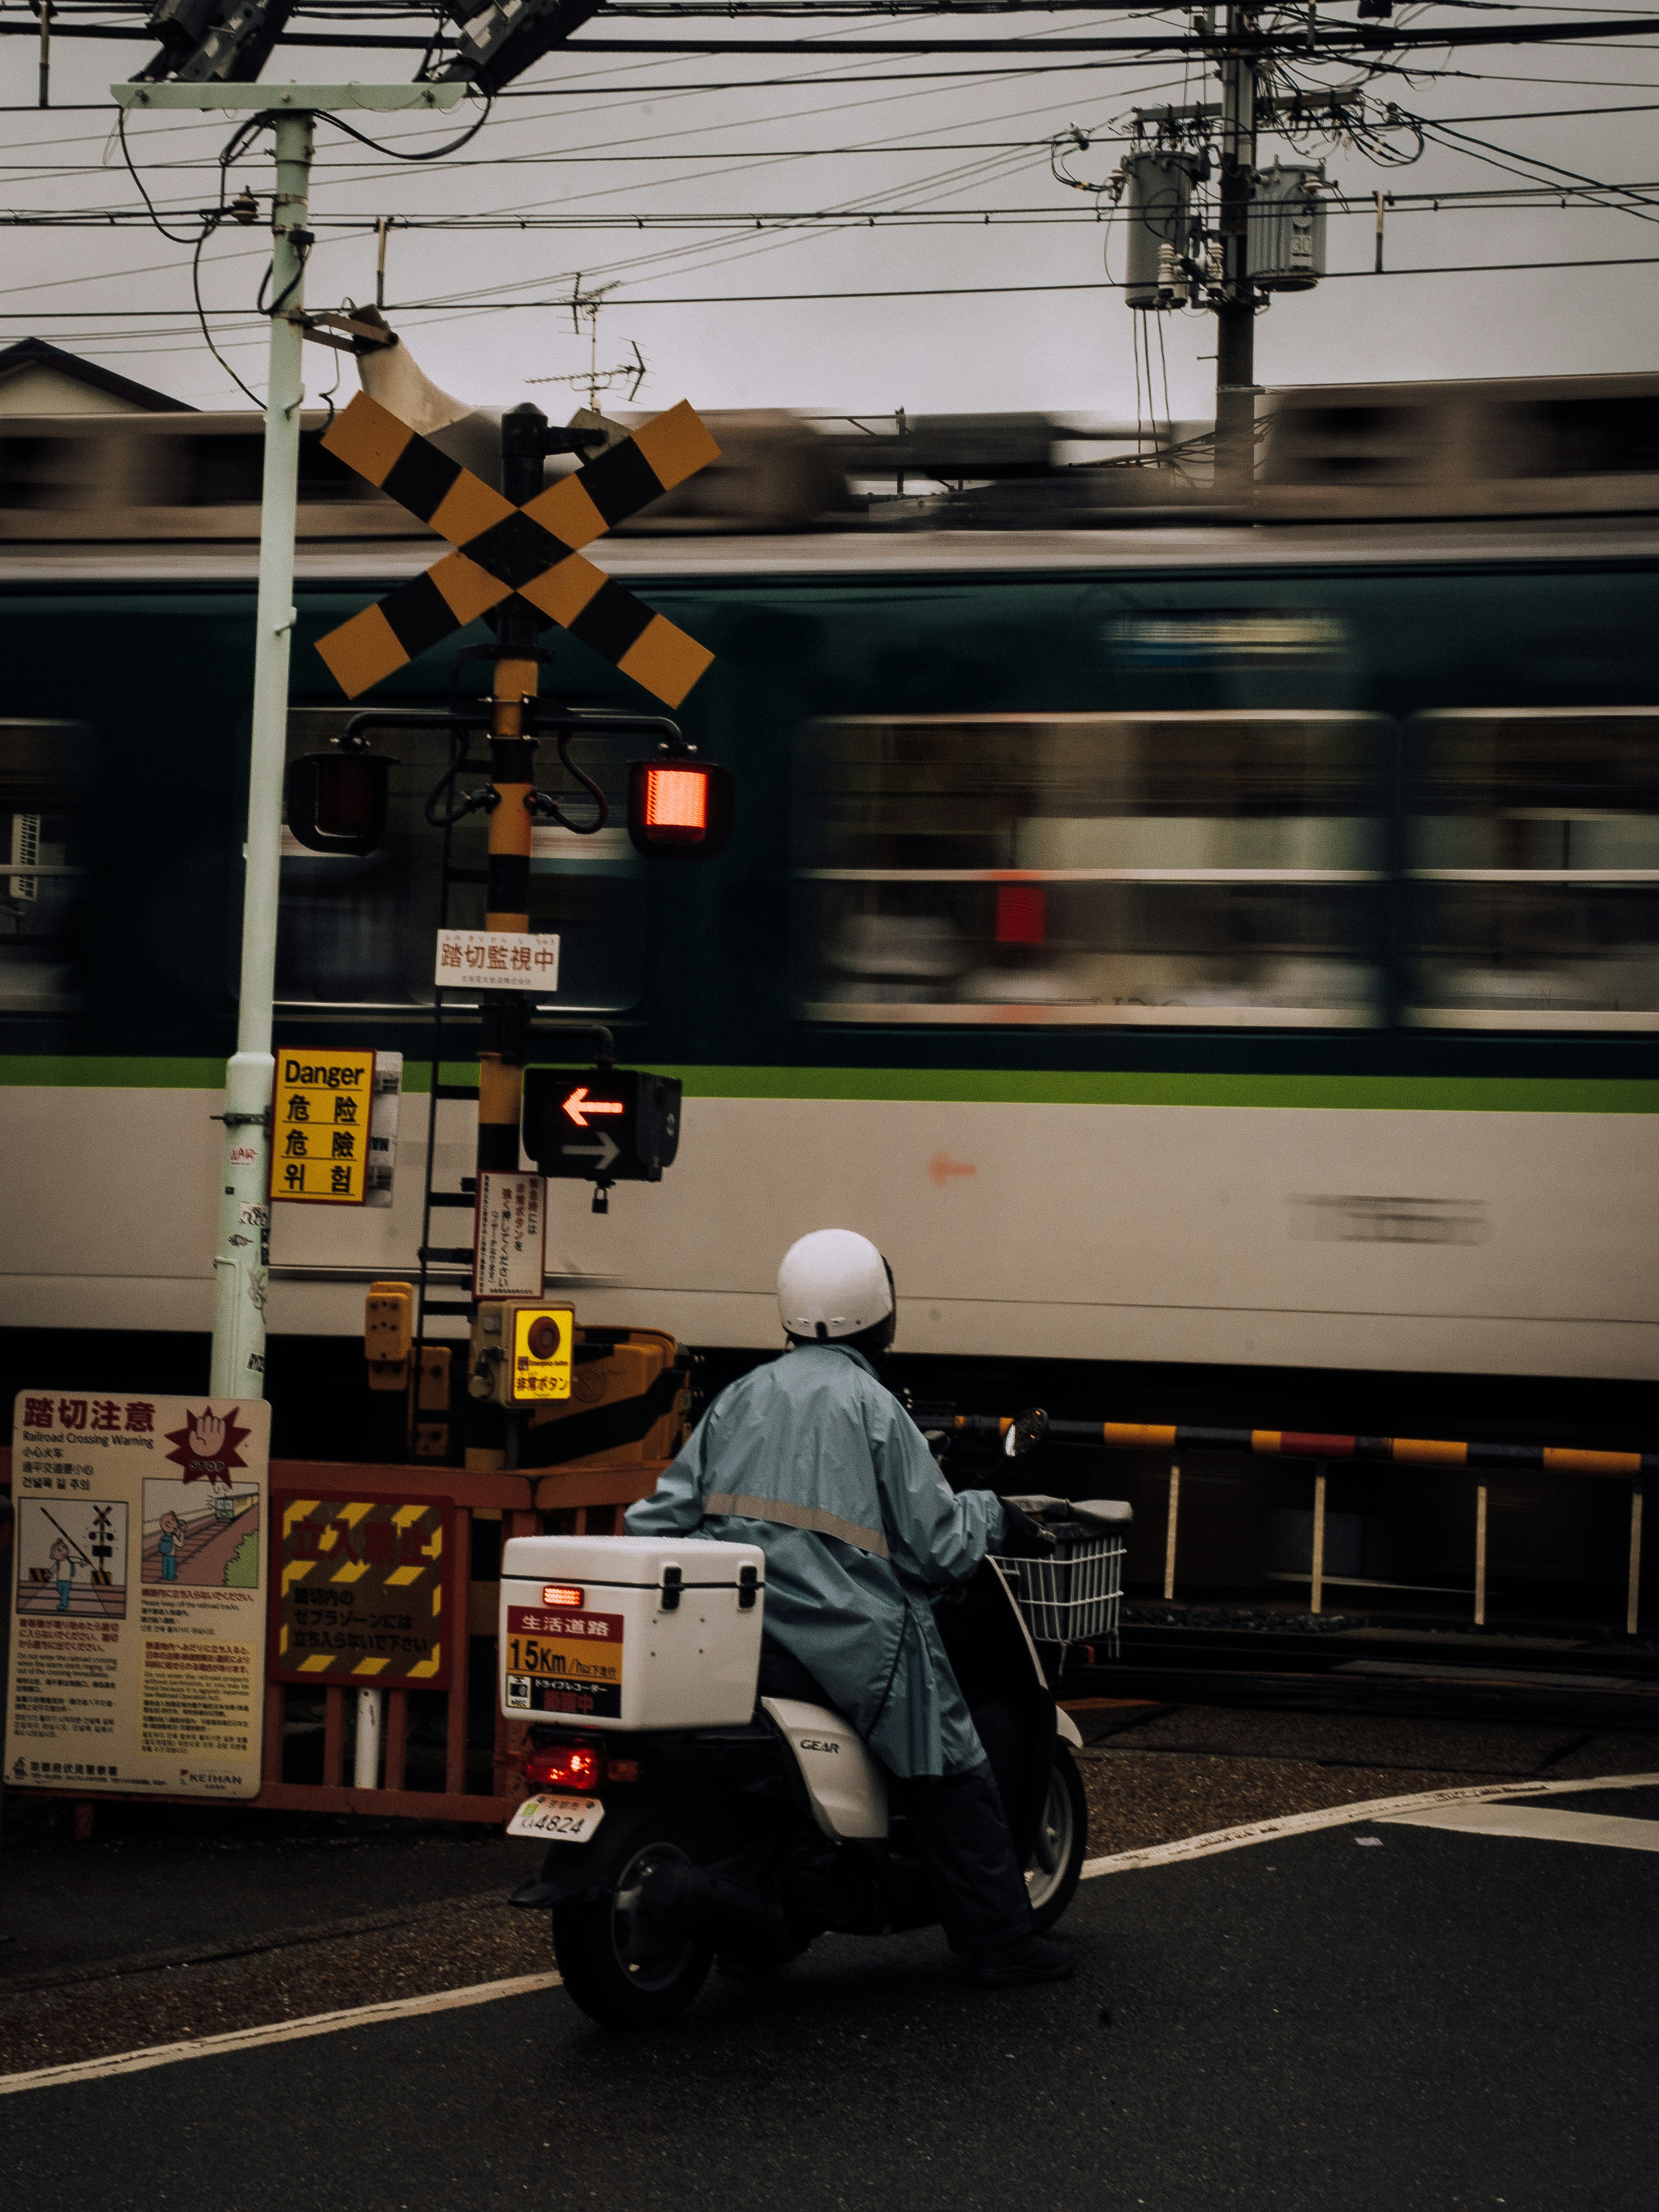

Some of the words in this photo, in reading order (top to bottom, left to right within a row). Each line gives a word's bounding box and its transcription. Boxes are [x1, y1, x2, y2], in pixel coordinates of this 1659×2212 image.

[441, 943, 554, 971] 踏切監視中
[286, 1060, 364, 1088] Danger
[288, 1094, 358, 1123] 危险
[286, 1129, 355, 1159] 危險
[284, 1164, 352, 1193] 위험
[23, 1397, 155, 1432] 踏切注意
[23, 1431, 64, 1442] Railroad
[66, 1433, 109, 1447] Crossing
[111, 1435, 154, 1450] Warning
[189, 1460, 224, 1471] STOP
[291, 1518, 432, 1565] 立入禁止
[521, 1615, 609, 1637] 生活道路
[800, 1739, 840, 1754] GEAR
[190, 1773, 242, 1784] KEIHAN
[535, 1814, 584, 1834] 4824
